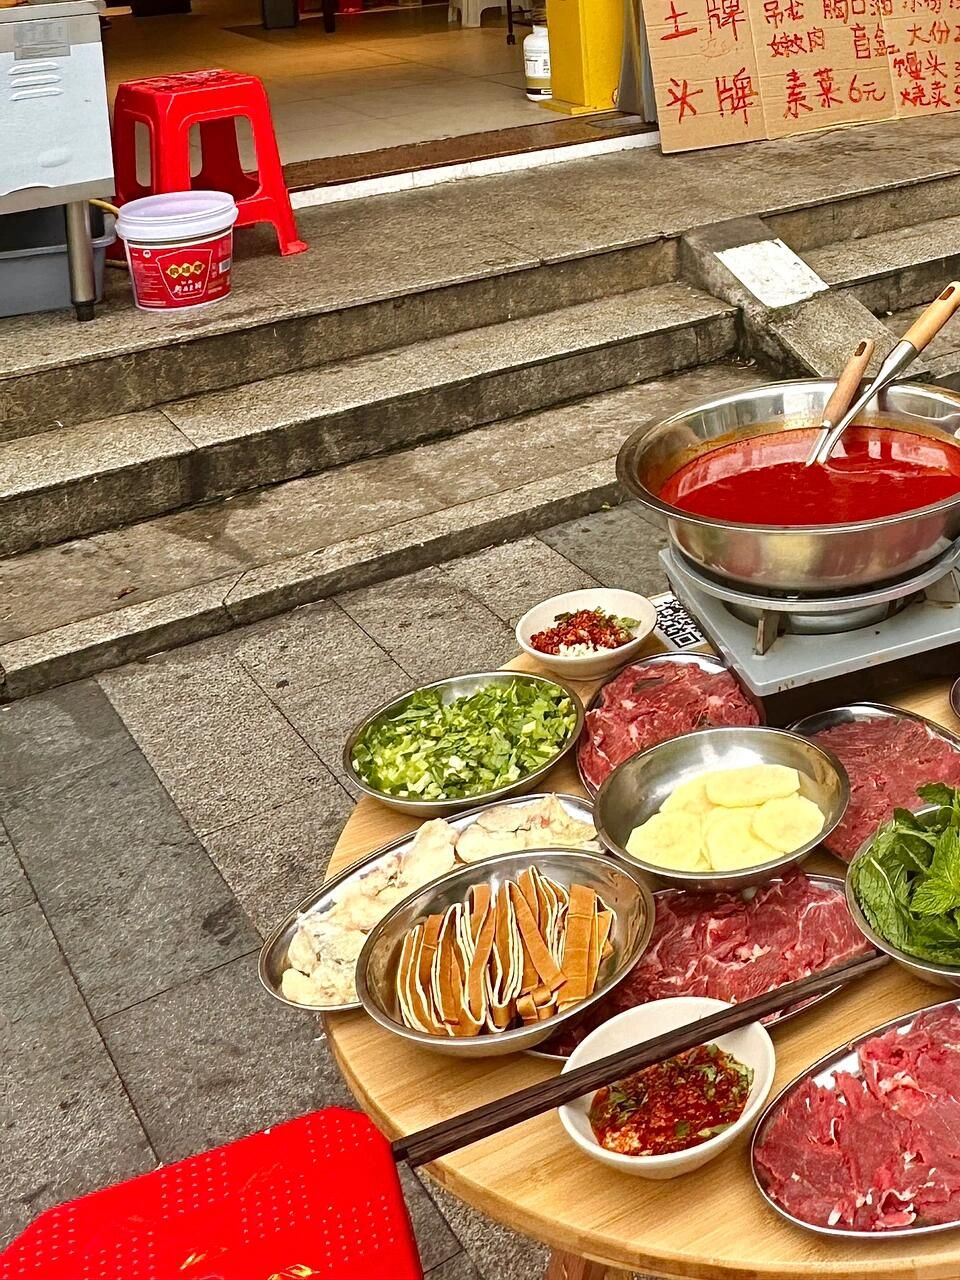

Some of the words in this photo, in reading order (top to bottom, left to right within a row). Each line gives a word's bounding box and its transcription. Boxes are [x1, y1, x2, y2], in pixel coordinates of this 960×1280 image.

[764, 0, 804, 29] 吊龙
[767, 26, 826, 58] 嫩肉
[851, 23, 900, 59] 盲盒
[907, 20, 950, 46] 大份
[893, 51, 947, 81] 馒头
[666, 67, 759, 128] 头牌
[784, 67, 843, 119] 素菜
[848, 75, 886, 104] 6元
